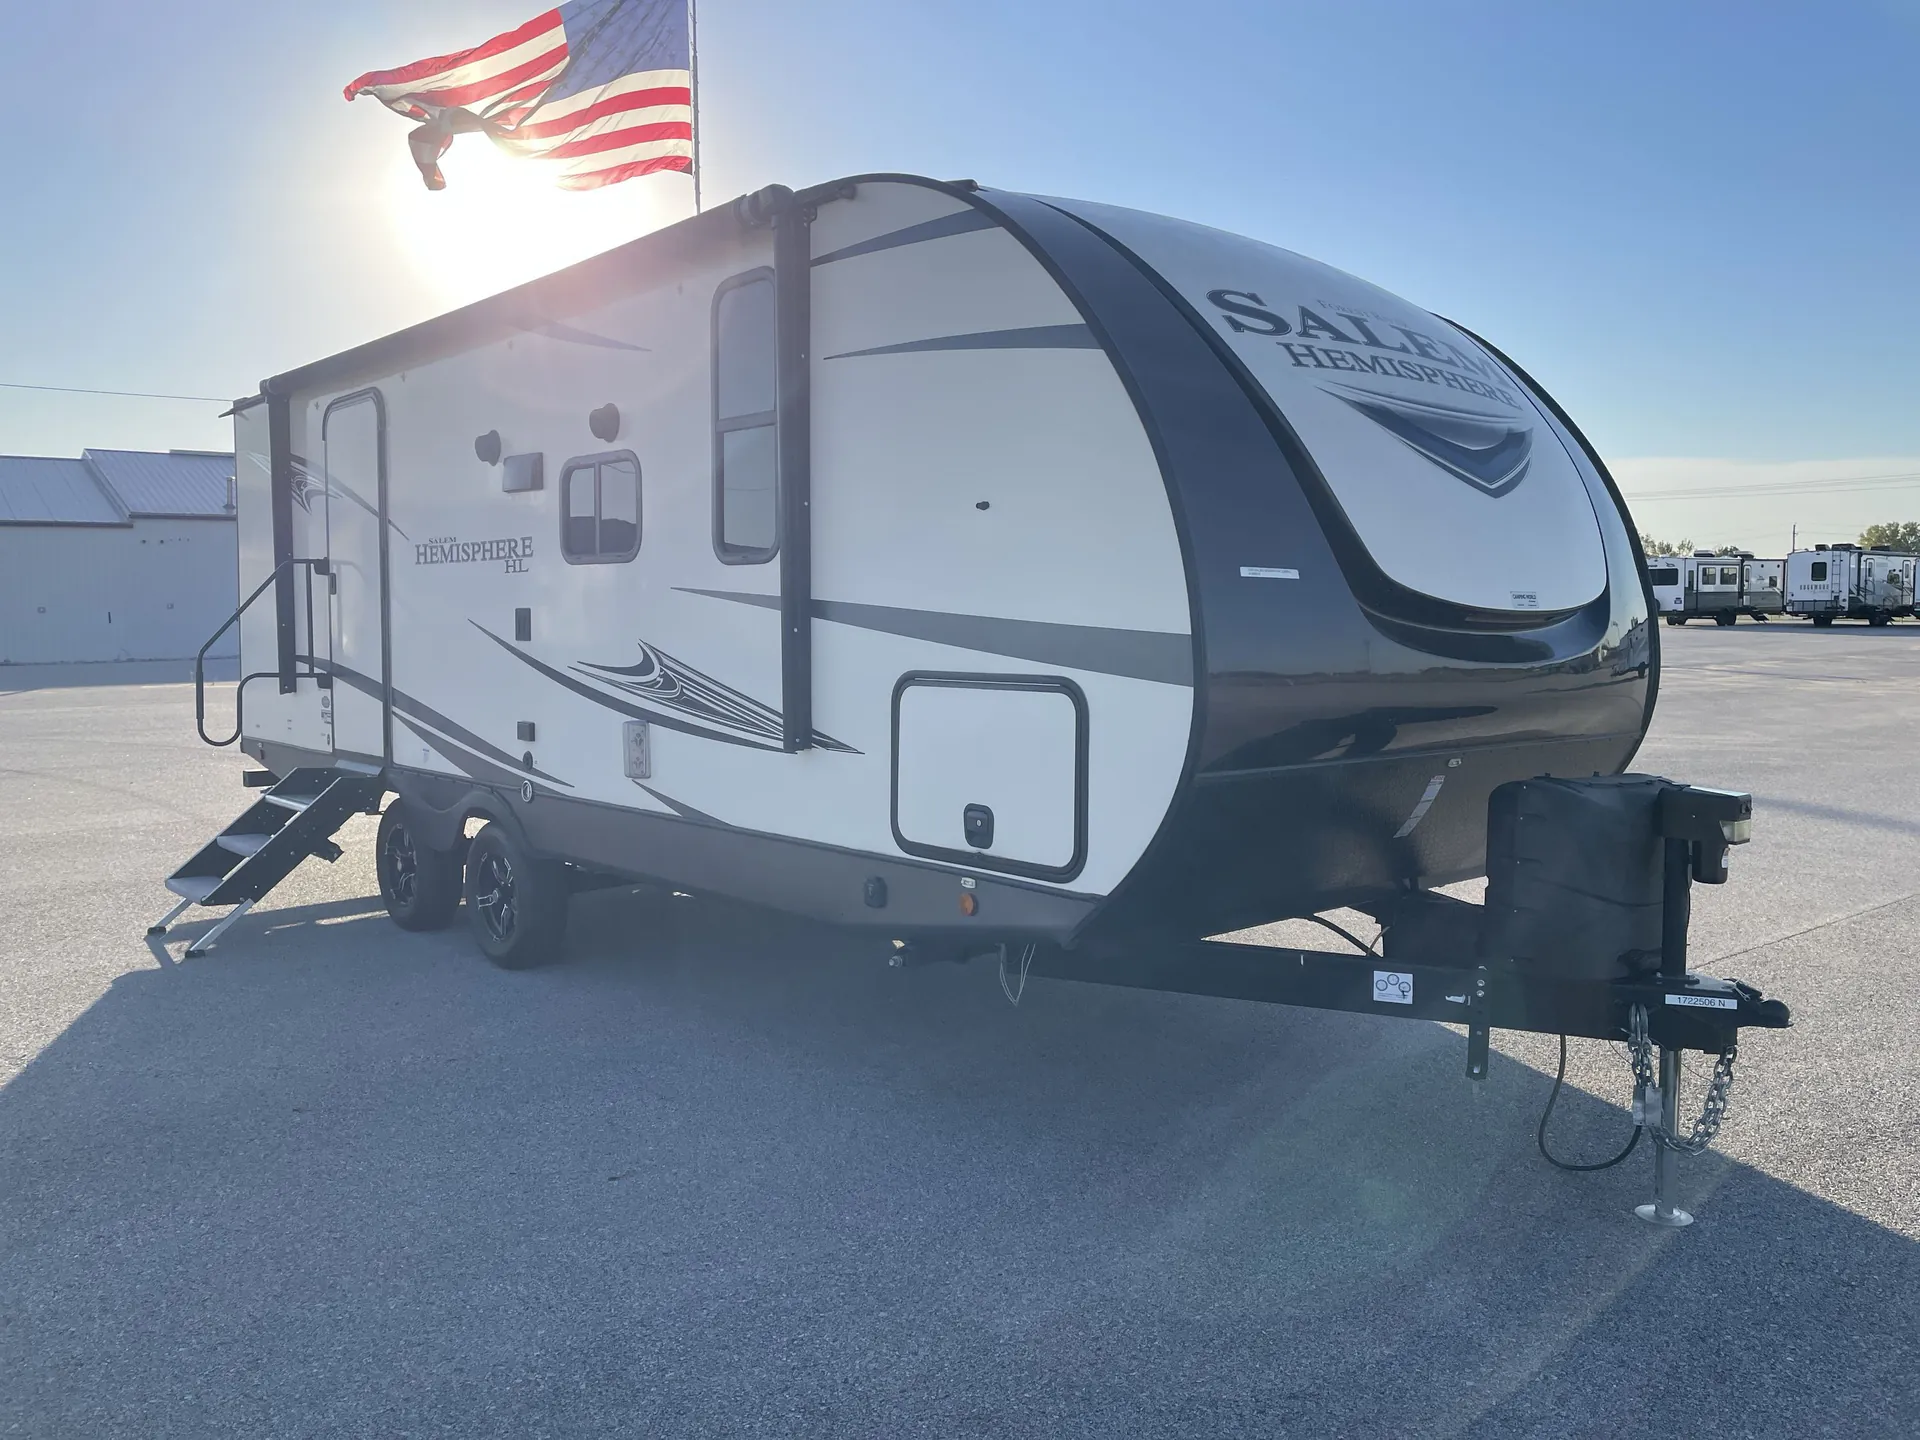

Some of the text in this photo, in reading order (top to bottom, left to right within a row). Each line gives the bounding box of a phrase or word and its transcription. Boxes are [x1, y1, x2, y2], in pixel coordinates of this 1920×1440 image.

[1206, 288, 1517, 393] SALEM
[1276, 342, 1524, 411] HEMISPHERE
[415, 536, 534, 565] HEMISPHERE
[504, 558, 529, 573] HL
[1677, 996, 1726, 1007] 1722506 N
